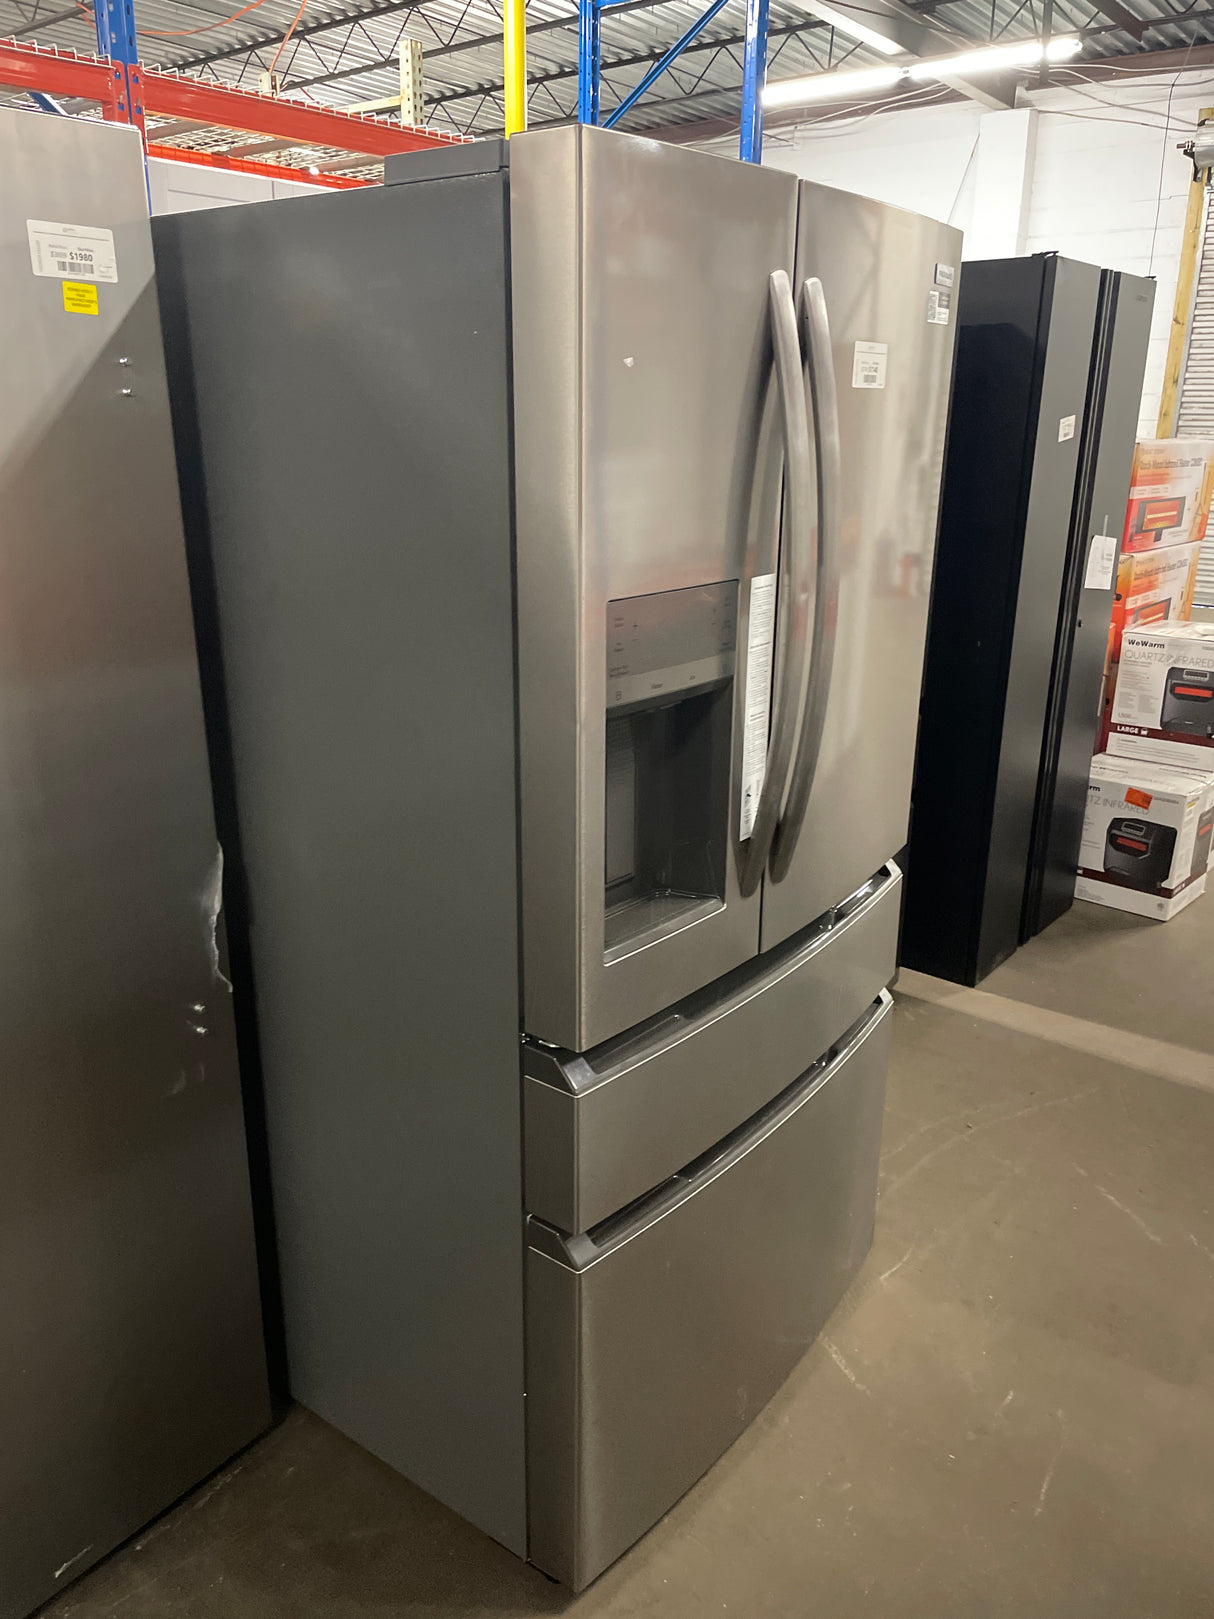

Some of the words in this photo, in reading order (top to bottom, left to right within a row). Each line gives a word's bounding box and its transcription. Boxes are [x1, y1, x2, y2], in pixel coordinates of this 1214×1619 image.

[69, 252, 93, 262] $1980
[1128, 639, 1165, 649] WeWarm
[1124, 650, 1165, 663] QUARTZ
[1166, 654, 1214, 668] INFRARED
[1117, 725, 1139, 734] LARGE
[1088, 795, 1102, 806] TZ
